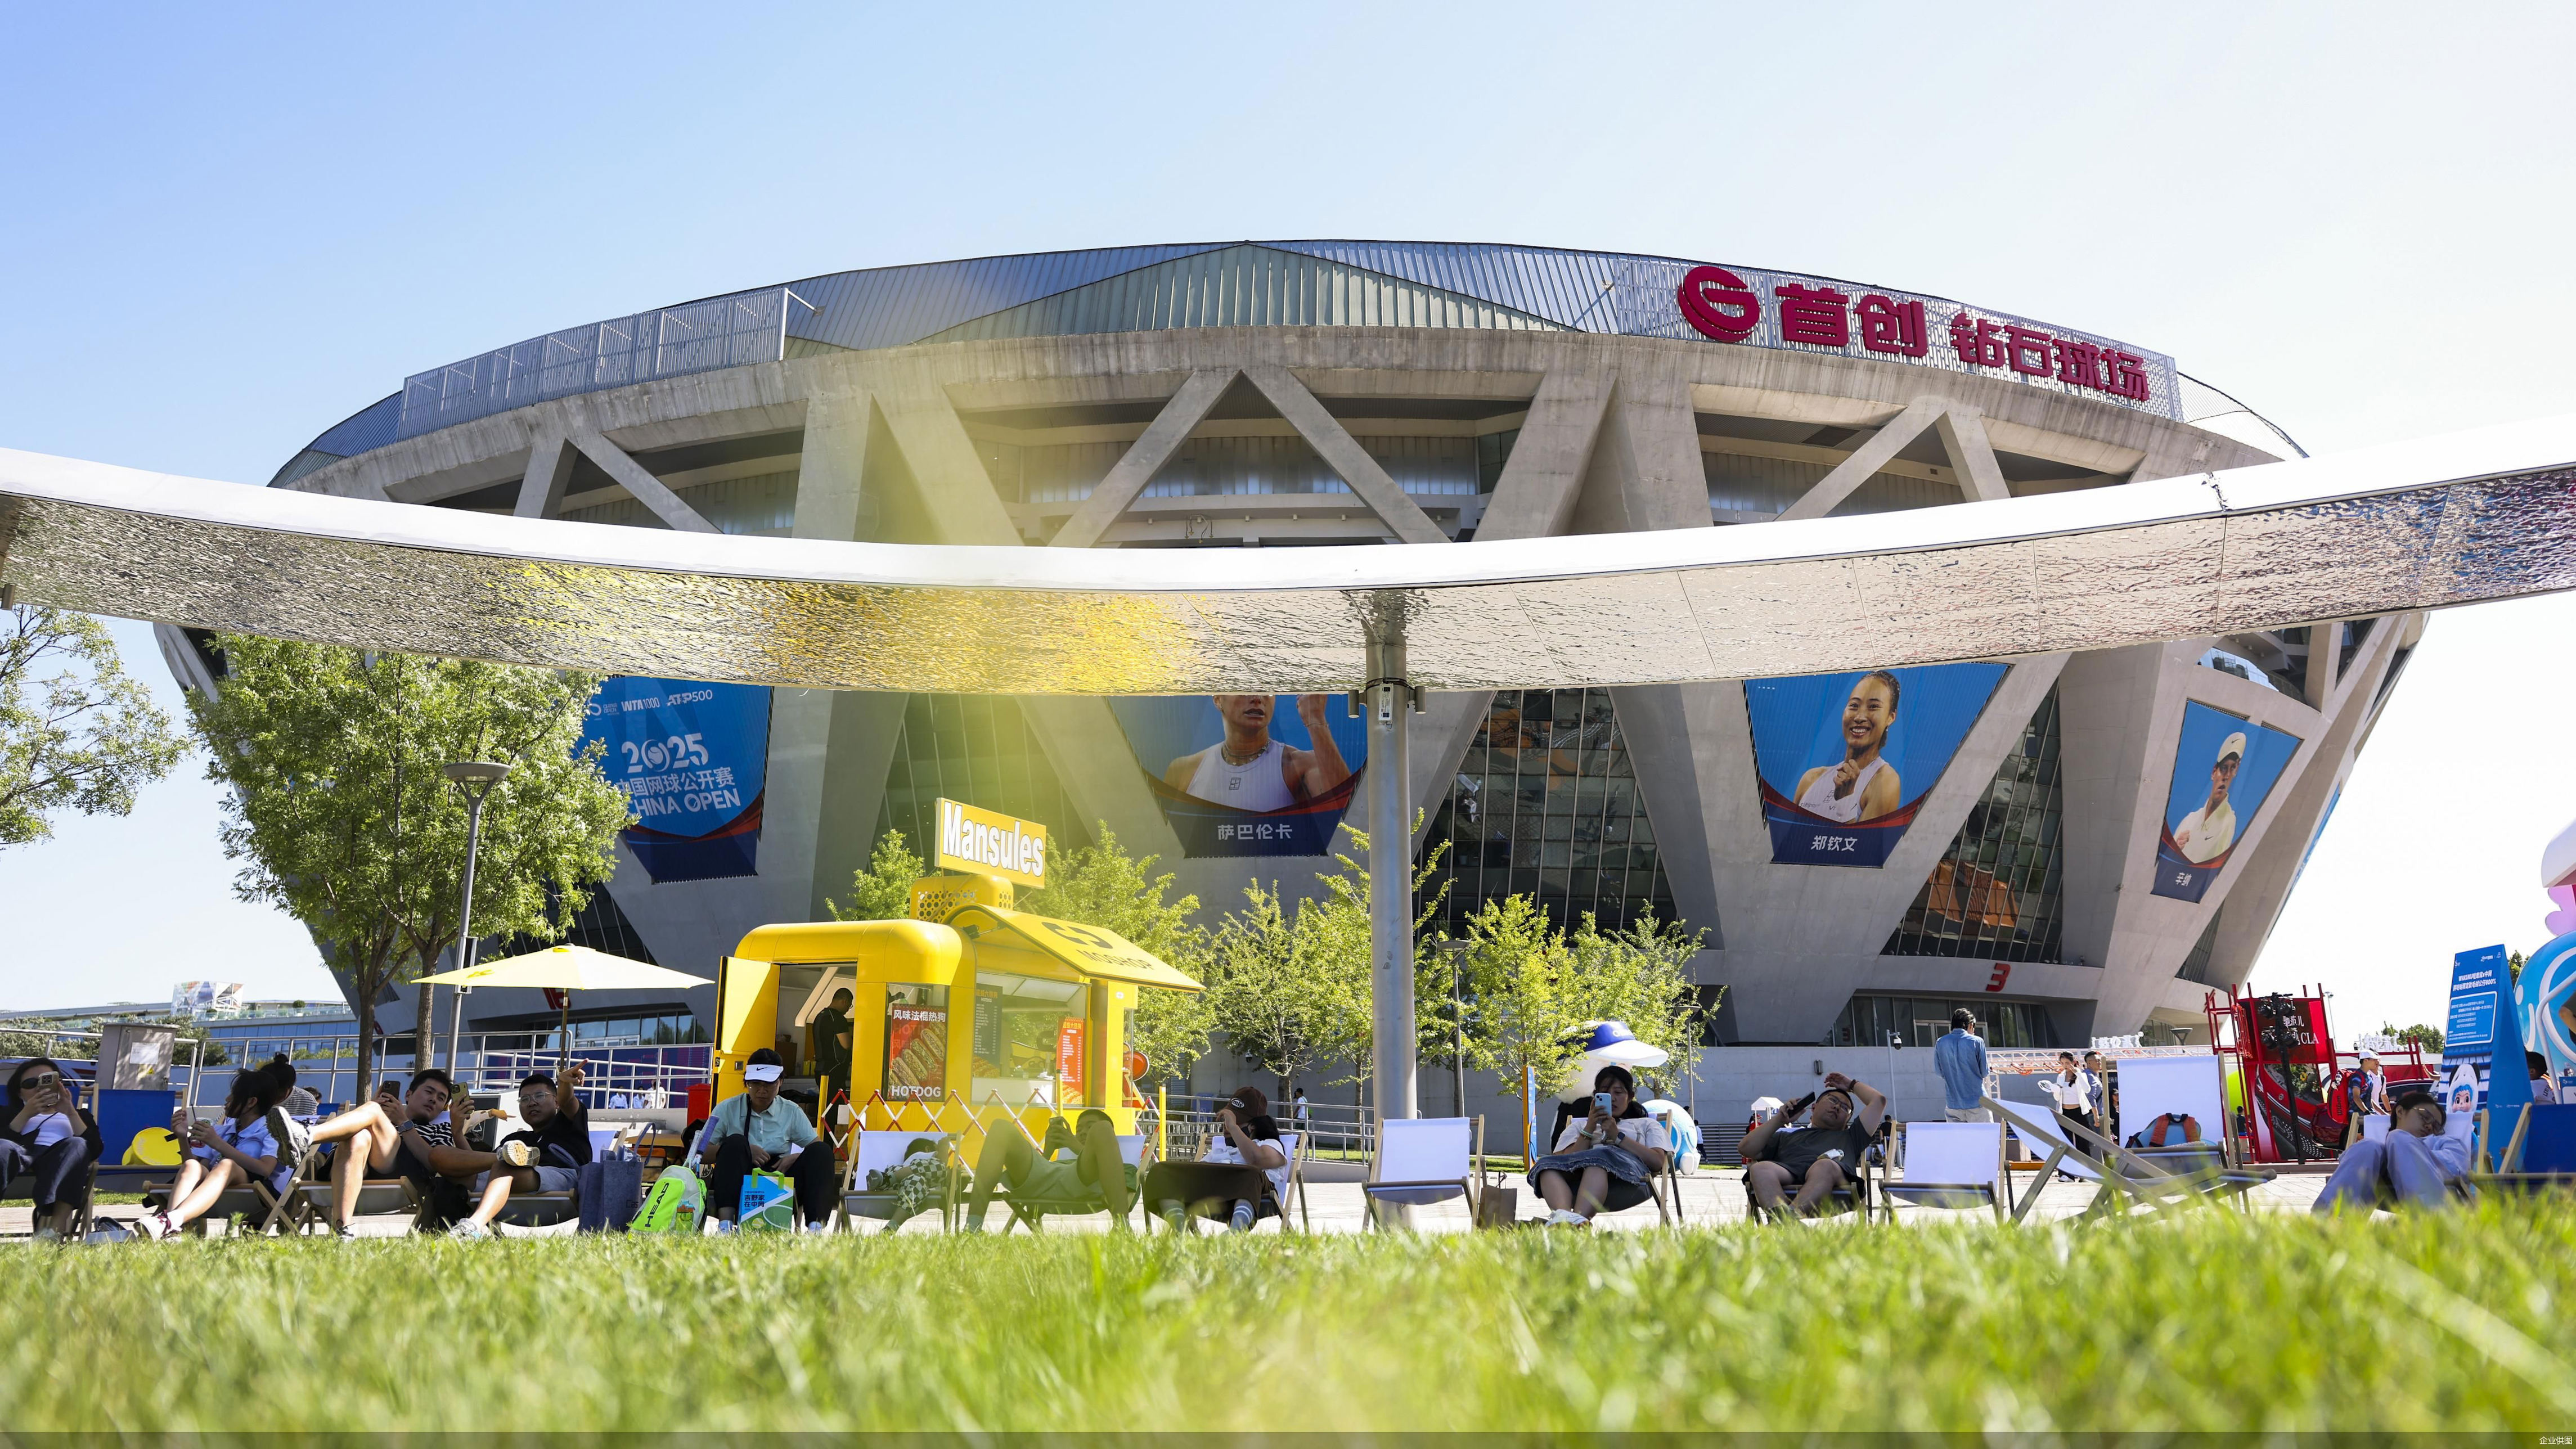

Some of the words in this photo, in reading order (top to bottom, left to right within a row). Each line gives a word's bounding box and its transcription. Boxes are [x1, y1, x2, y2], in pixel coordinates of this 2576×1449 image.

[1775, 283, 1930, 358] 首创
[1949, 311, 2151, 402] 钻石球场
[621, 732, 709, 773] 2025
[684, 788, 741, 812] OPEN
[942, 800, 1044, 878] Mansules
[1217, 824, 1293, 841] 萨巴伦卡
[1810, 835, 1858, 852] 郑钦文
[1076, 949, 1154, 970] MOSHOP
[1985, 962, 2011, 992] 3
[893, 1009, 946, 1023] 风味法棍热狗
[2300, 1032, 2319, 1045] CLA
[891, 1085, 942, 1097] HOTDOG
[645, 1182, 670, 1228] HEAD
